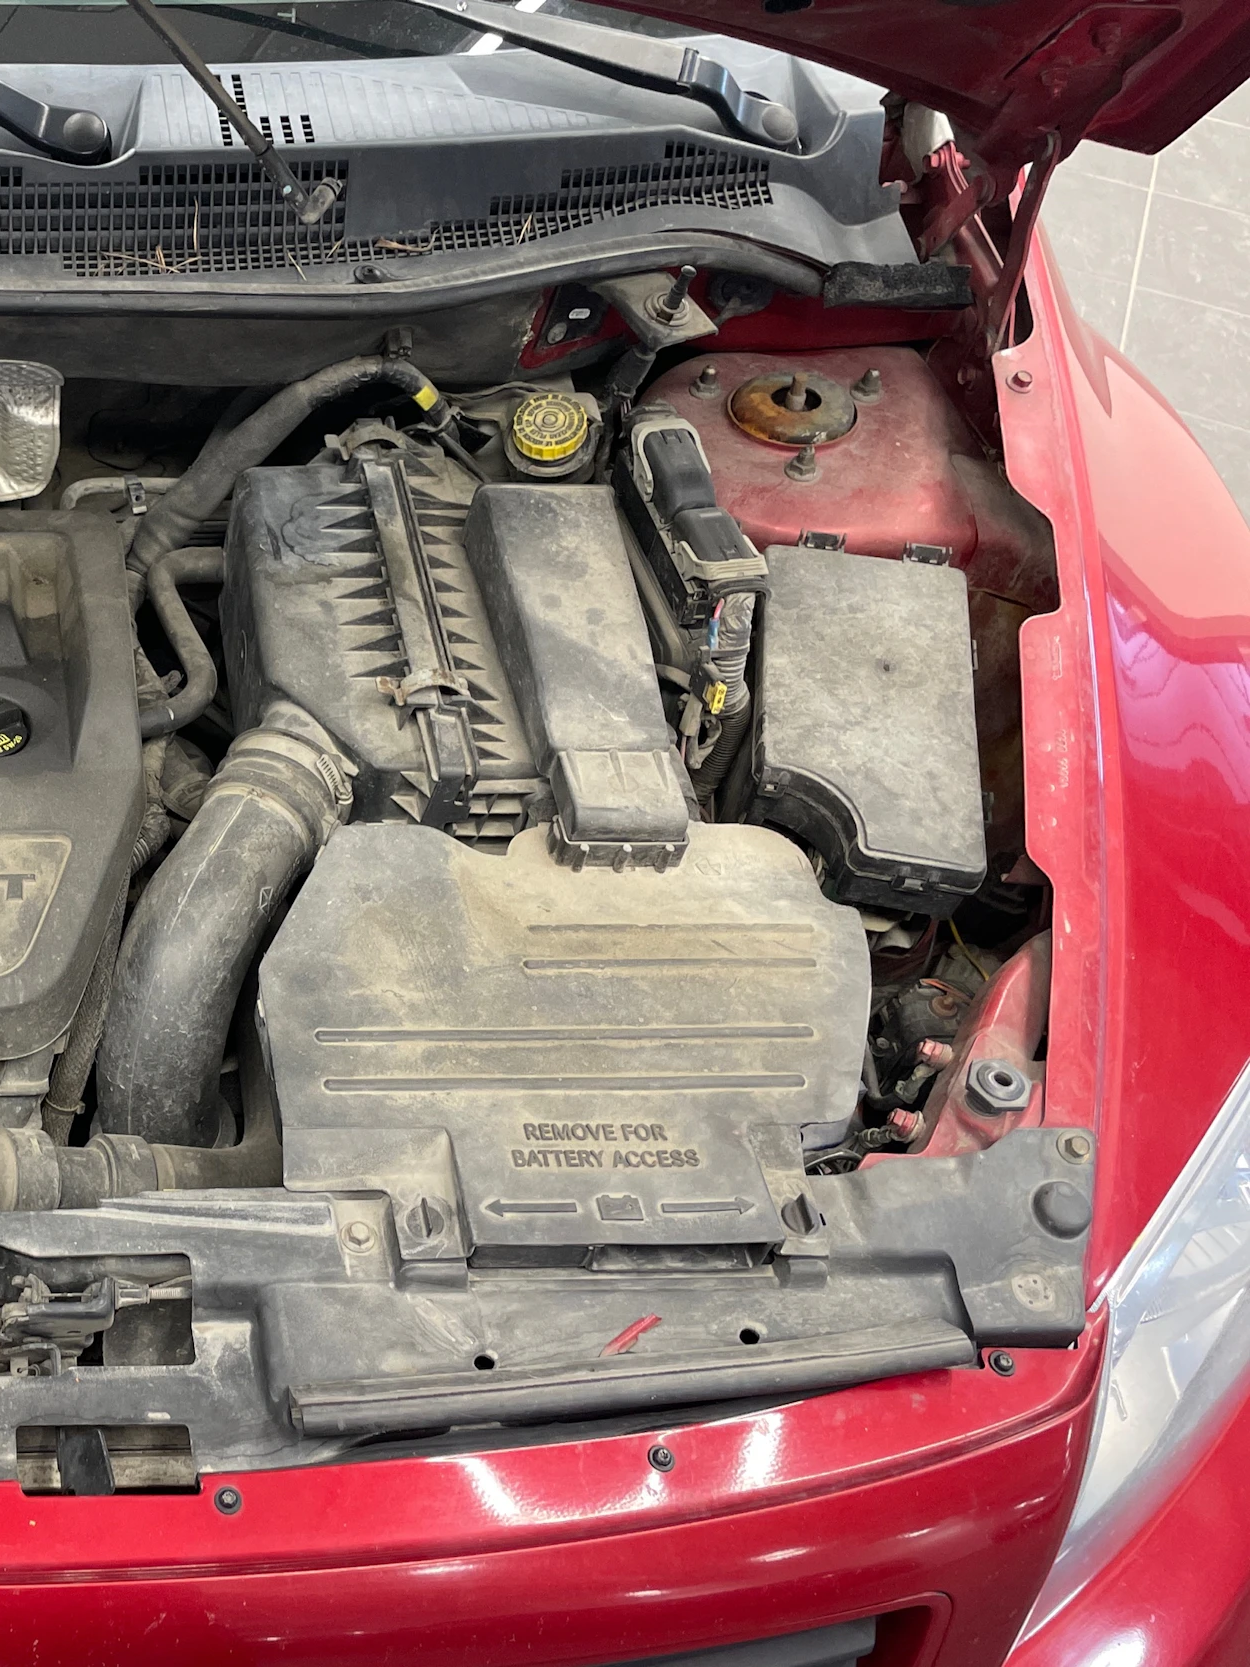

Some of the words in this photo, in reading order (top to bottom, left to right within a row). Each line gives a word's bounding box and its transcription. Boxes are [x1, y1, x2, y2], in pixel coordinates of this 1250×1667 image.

[523, 1122, 617, 1142] REMOVE
[620, 1123, 668, 1142] FOR
[511, 1149, 605, 1168] BATTERY
[612, 1148, 700, 1168] ACCESS
